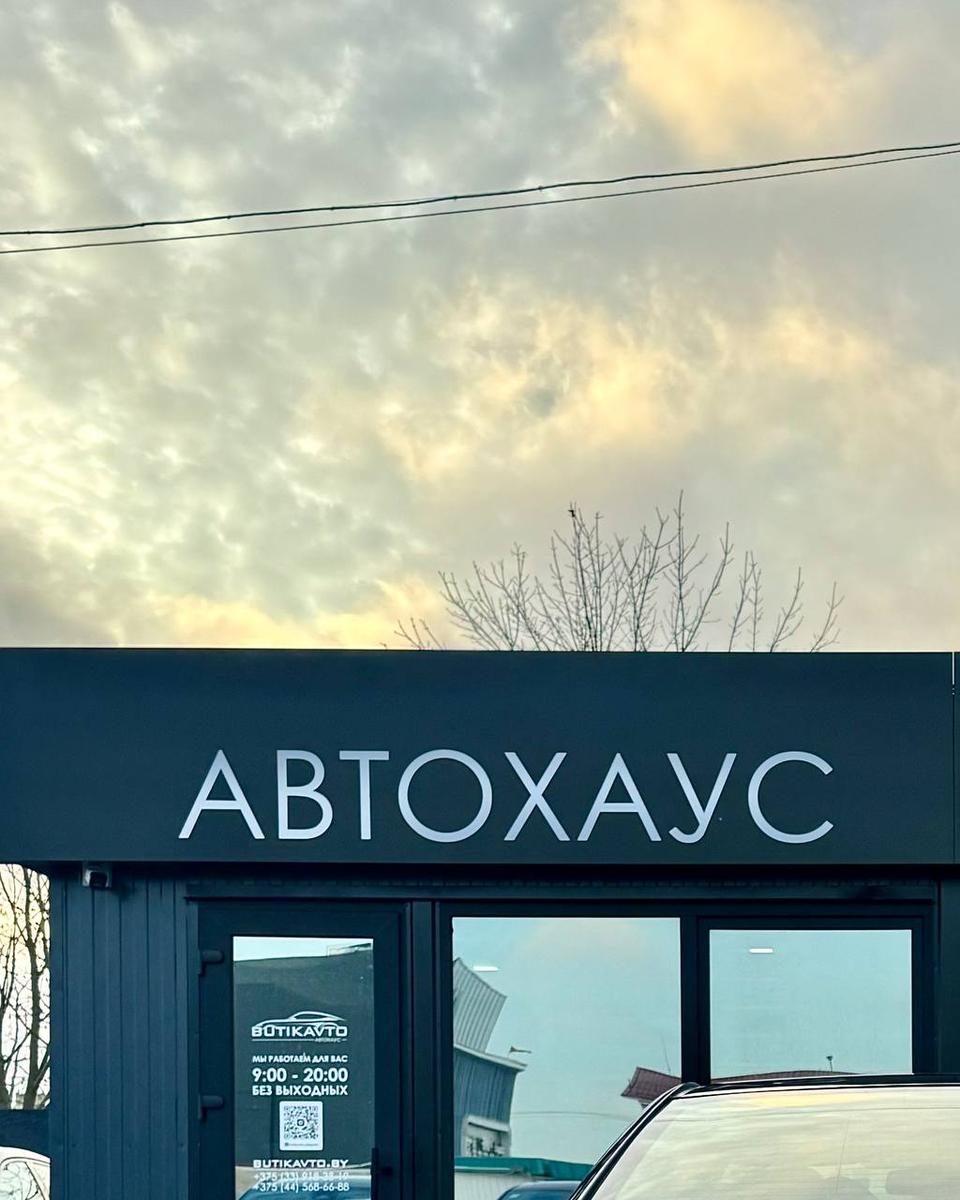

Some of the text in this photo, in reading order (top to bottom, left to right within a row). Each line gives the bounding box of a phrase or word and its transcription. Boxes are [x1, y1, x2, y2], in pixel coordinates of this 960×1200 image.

[178, 748, 834, 844] АВТОХАУС
[251, 1026, 348, 1037] BUTIKAVTO
[252, 1055, 348, 1063] МЫ РАБОТАЕМ ДЛЯ ВАС
[252, 1068, 287, 1082] 9:00
[303, 1068, 349, 1082] 20:00
[252, 1085, 348, 1097] БЕЗ ВЫХОДНЫХ
[253, 1159, 349, 1168] BUTIKAVTO.BY
[253, 1182, 350, 1193] +375 (44) 568-66-88
